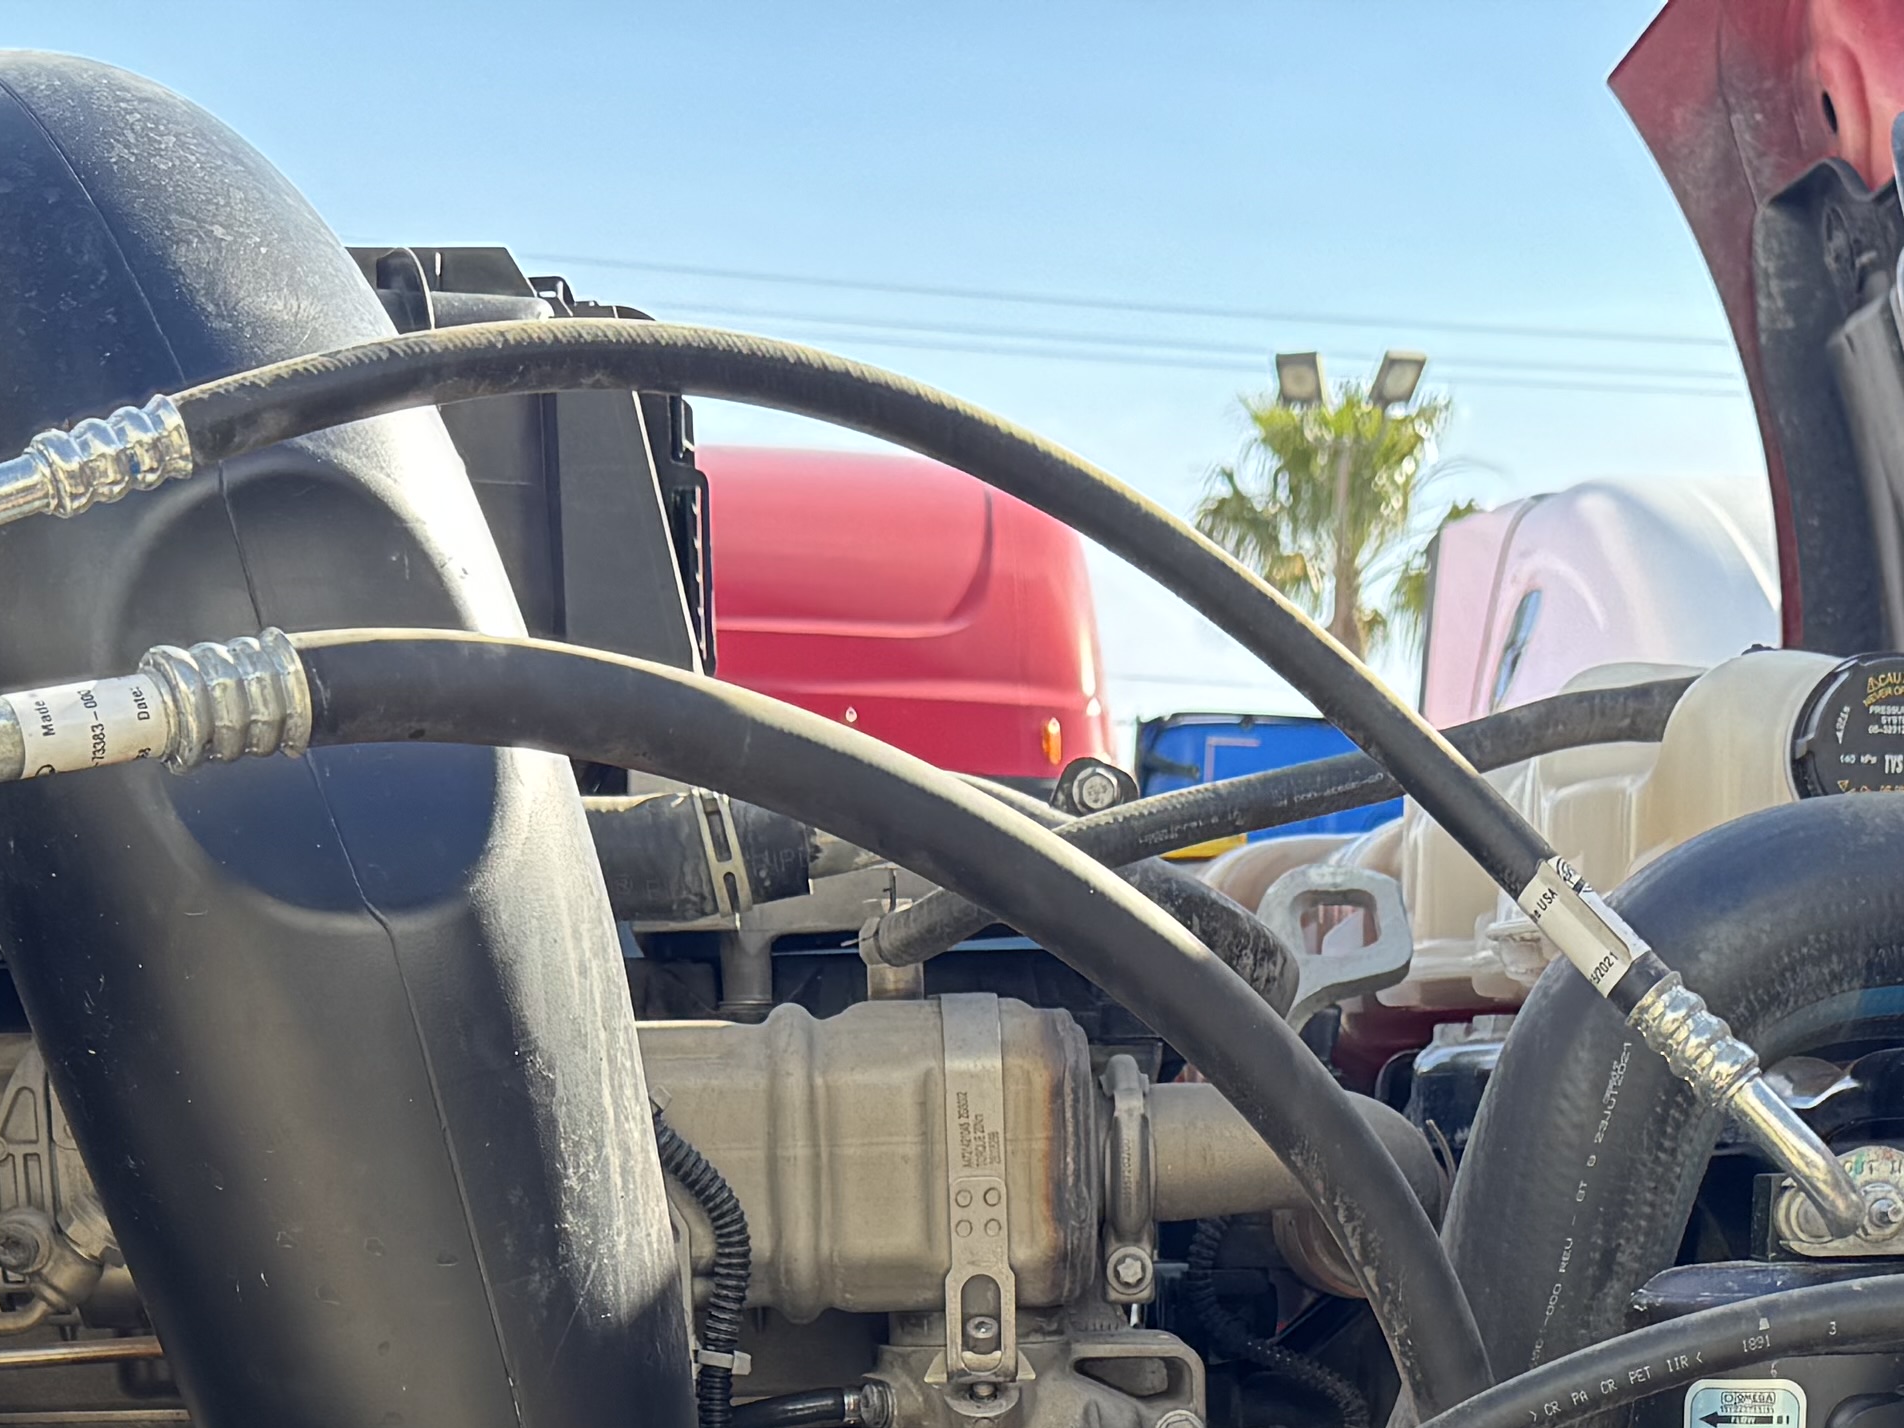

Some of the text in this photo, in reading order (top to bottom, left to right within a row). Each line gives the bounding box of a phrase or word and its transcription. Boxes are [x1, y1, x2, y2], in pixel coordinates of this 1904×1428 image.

[34, 700, 56, 736] Made
[1884, 754, 1904, 774] TVS
[1536, 887, 1559, 912] USA
[1543, 1400, 1562, 1417] CR
[1599, 1377, 1619, 1395] CR
[1627, 1365, 1653, 1385] PET
